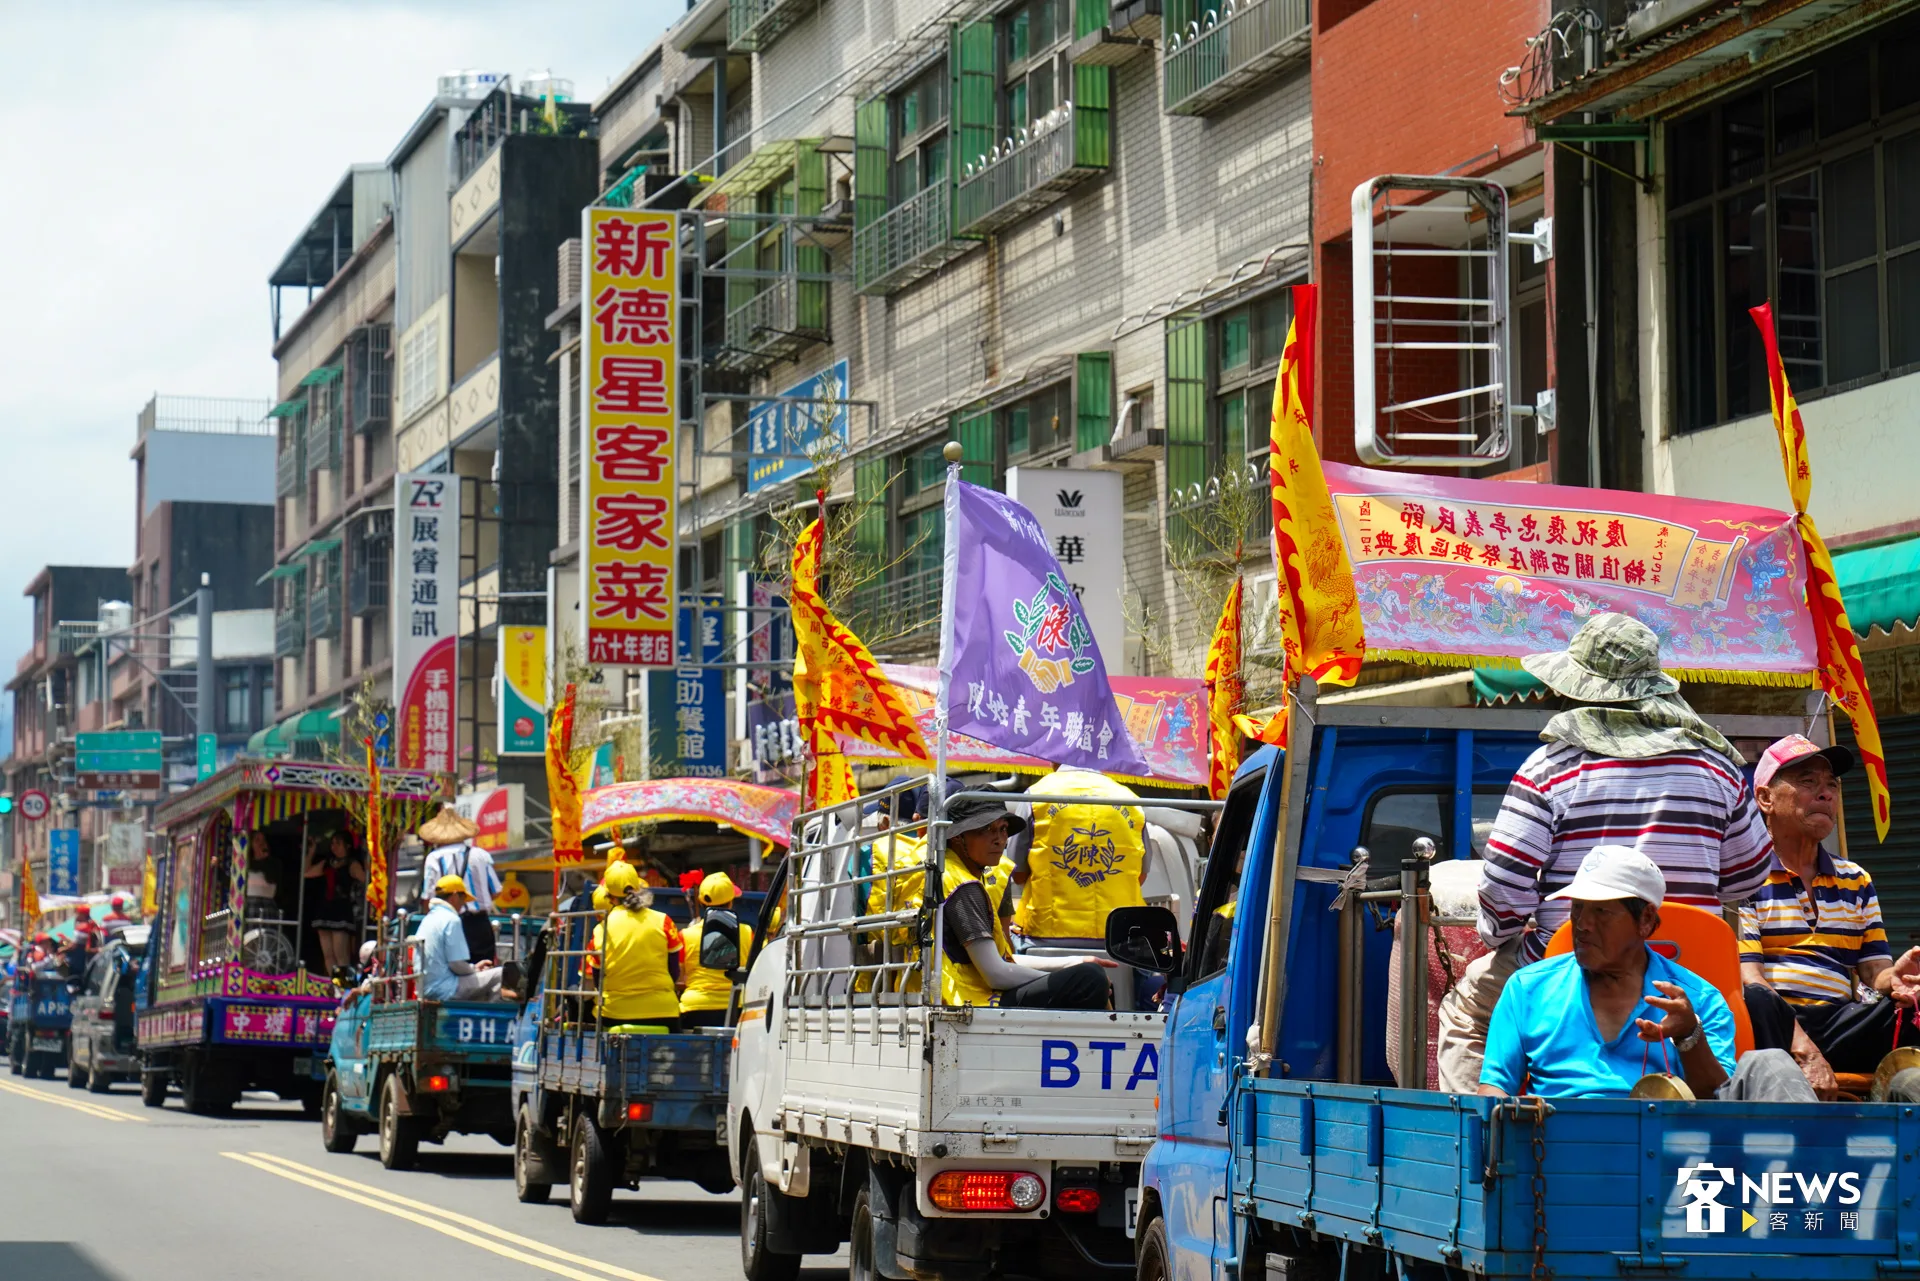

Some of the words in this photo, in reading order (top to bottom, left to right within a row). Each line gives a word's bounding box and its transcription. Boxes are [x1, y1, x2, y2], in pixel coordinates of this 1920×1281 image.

[592, 217, 672, 621] 新德星客家菜
[412, 516, 438, 638] 展睿通訊
[591, 632, 671, 663] 六十年老店
[1036, 604, 1070, 654] 陳
[967, 679, 1114, 760] 陳姓青年聯誼會
[1079, 844, 1100, 867] 陳
[1040, 1040, 1158, 1091] BTA
[959, 1096, 1022, 1108] 現代汽車
